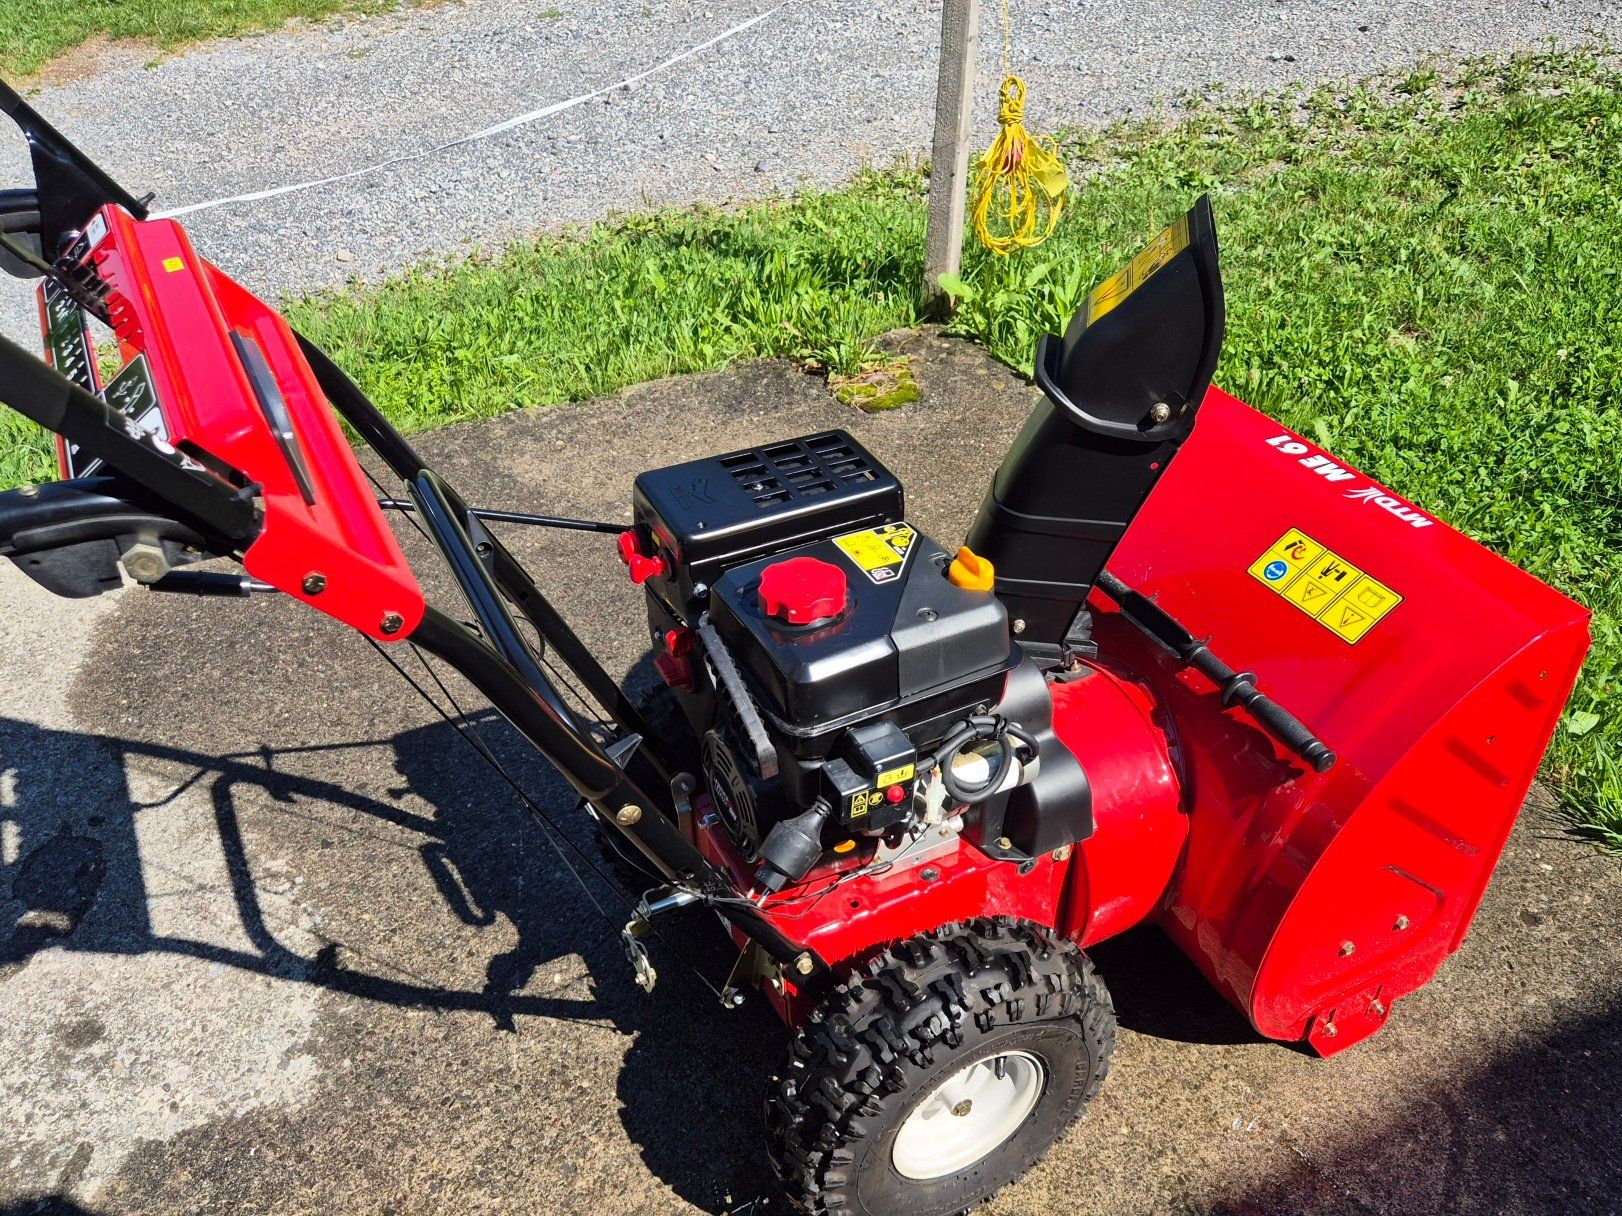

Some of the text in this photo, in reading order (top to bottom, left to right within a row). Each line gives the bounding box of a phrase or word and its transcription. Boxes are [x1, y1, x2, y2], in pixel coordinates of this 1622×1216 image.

[1265, 434, 1434, 528] MTD ME 61
